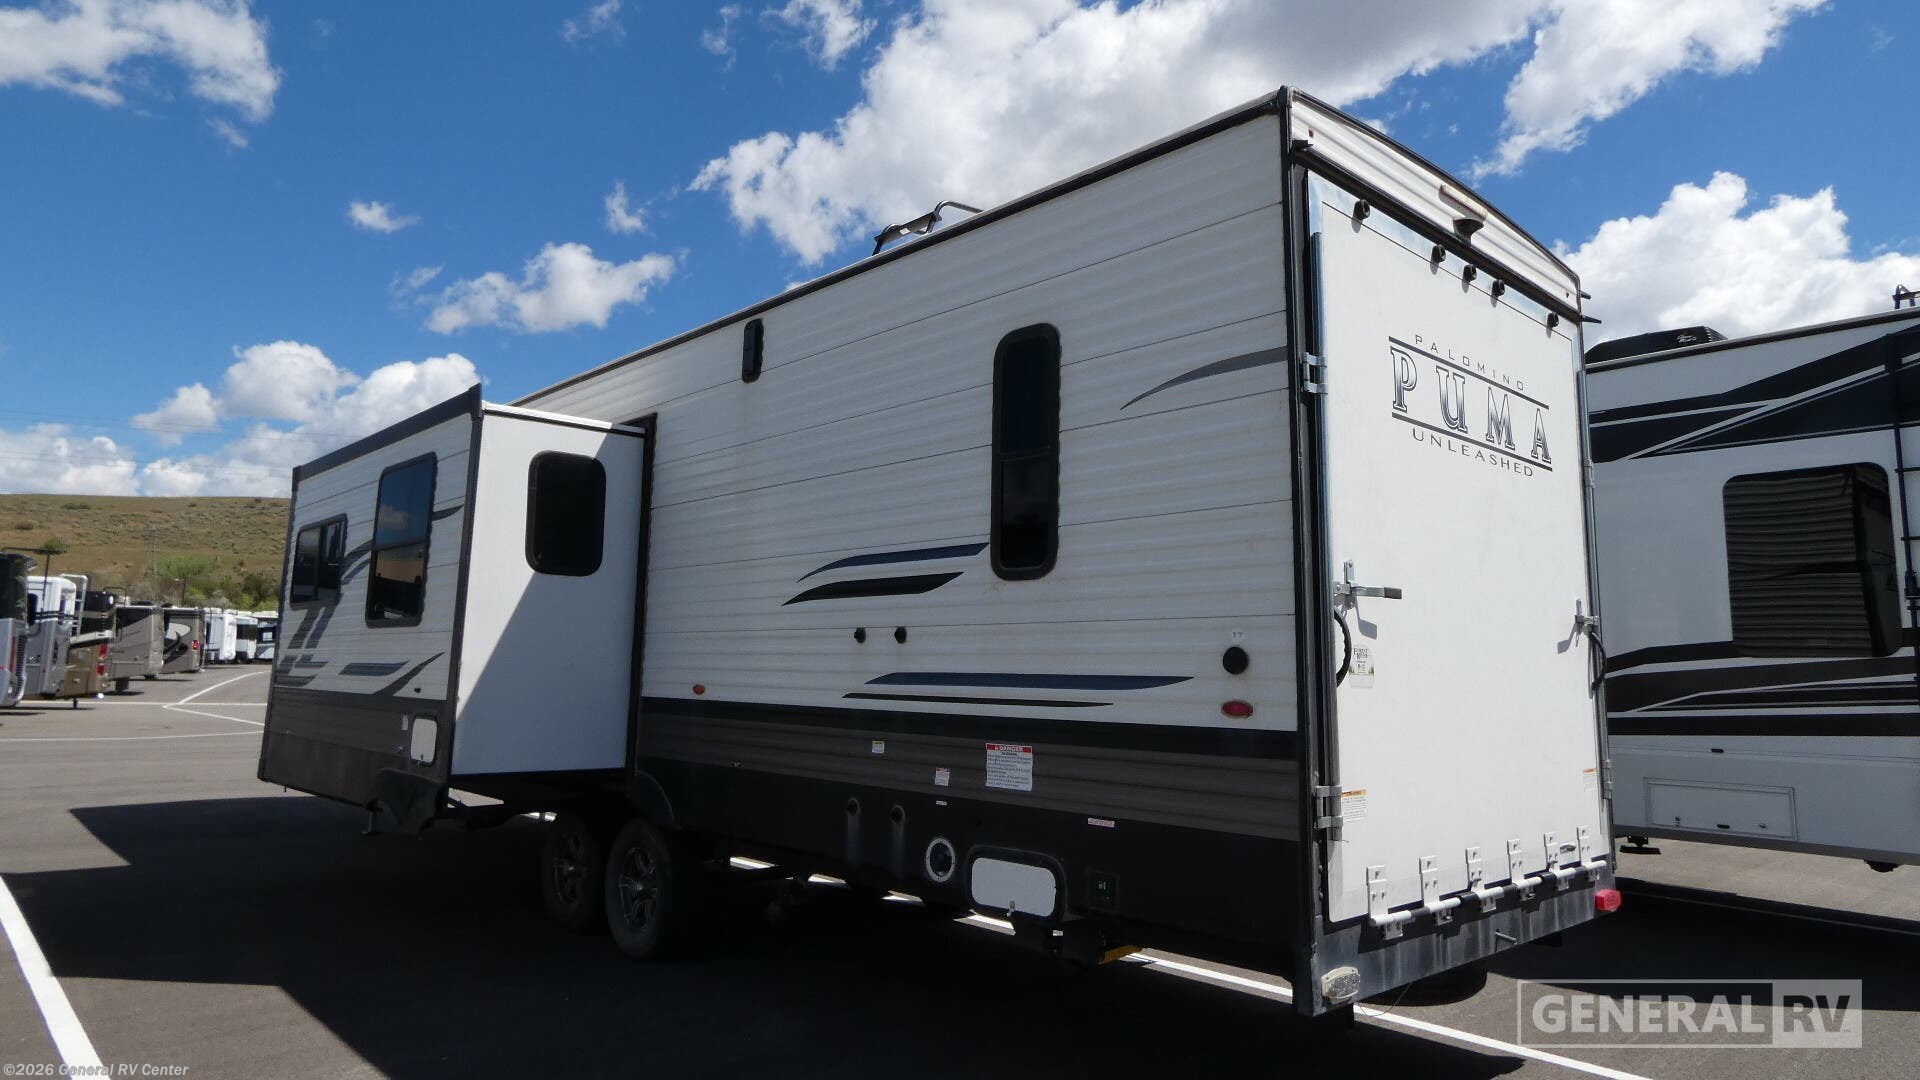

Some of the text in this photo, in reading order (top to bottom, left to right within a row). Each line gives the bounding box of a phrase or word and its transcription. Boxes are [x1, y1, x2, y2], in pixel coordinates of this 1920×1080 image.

[1415, 334, 1524, 391] PALOMINO
[1390, 346, 1552, 464] PUMA
[1412, 428, 1534, 477] UNLEASHED
